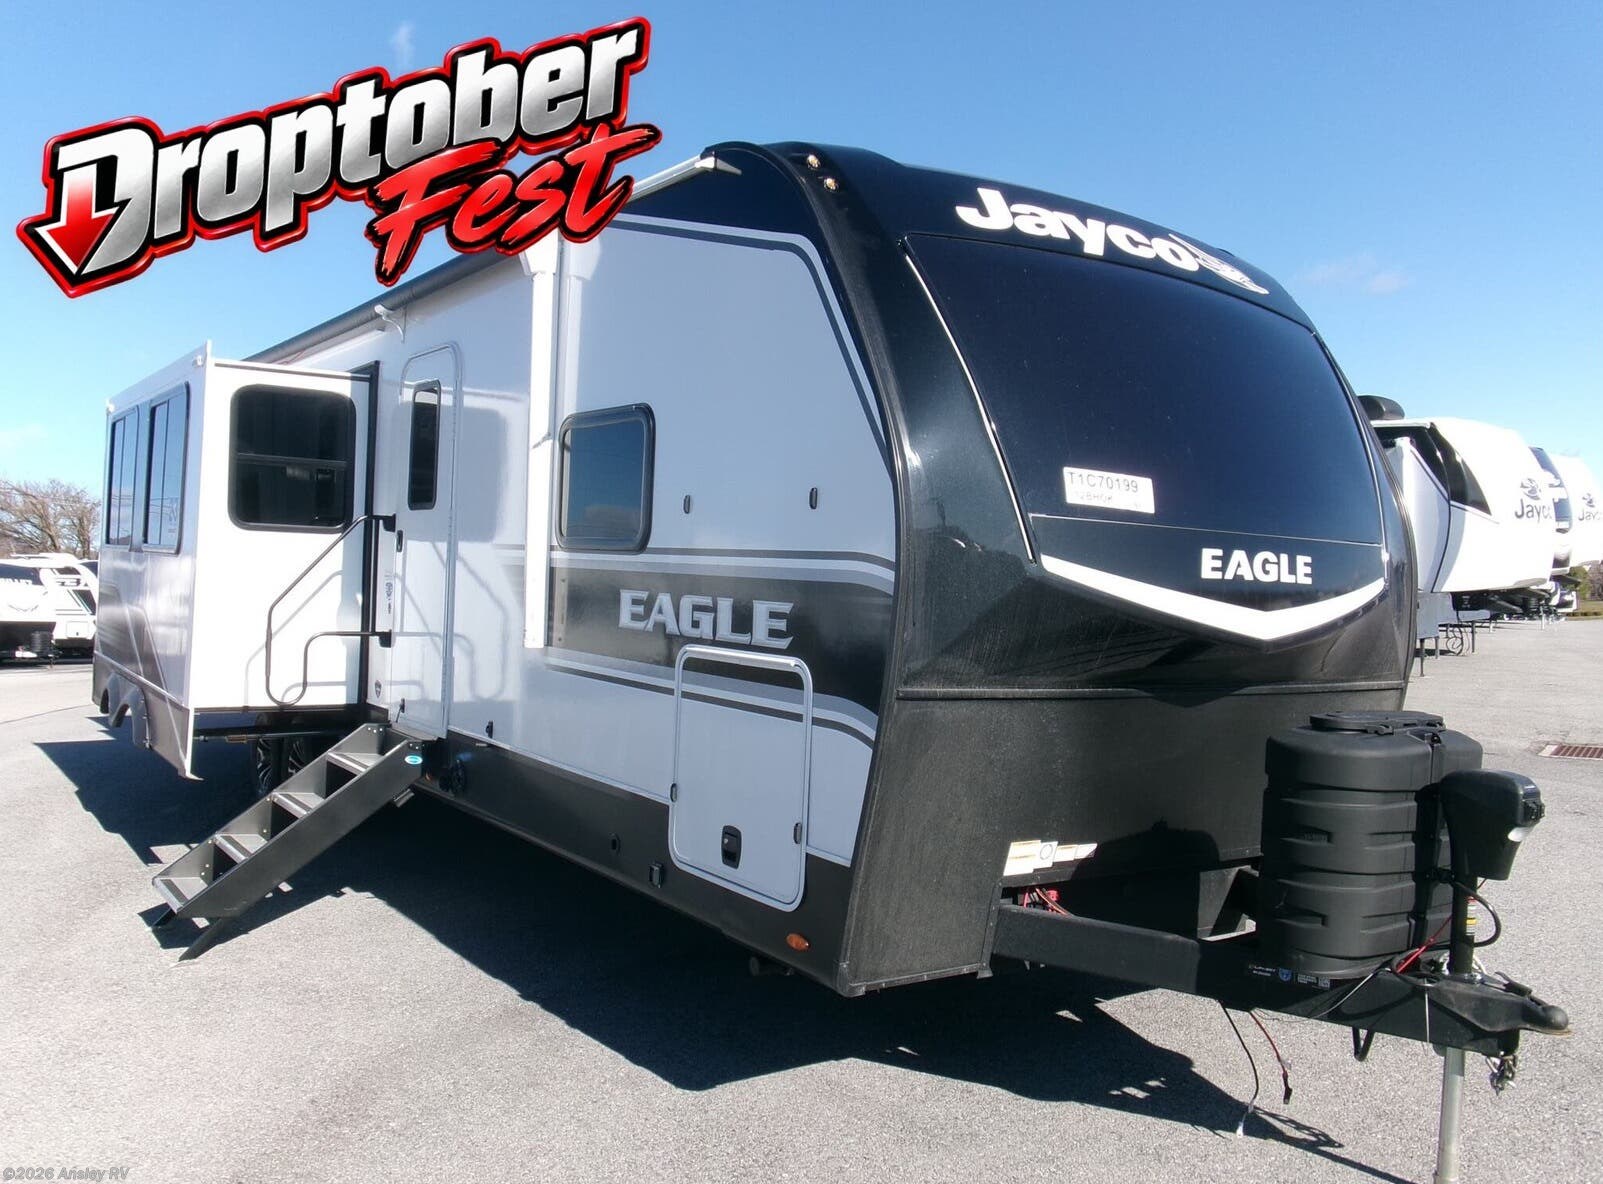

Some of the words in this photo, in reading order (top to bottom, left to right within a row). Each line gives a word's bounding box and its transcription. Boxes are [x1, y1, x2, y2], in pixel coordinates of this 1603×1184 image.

[955, 186, 1200, 272] Jayco
[1066, 471, 1139, 493] T1C70199
[1200, 547, 1313, 585] EAGLE
[618, 588, 795, 650] EAGLE
